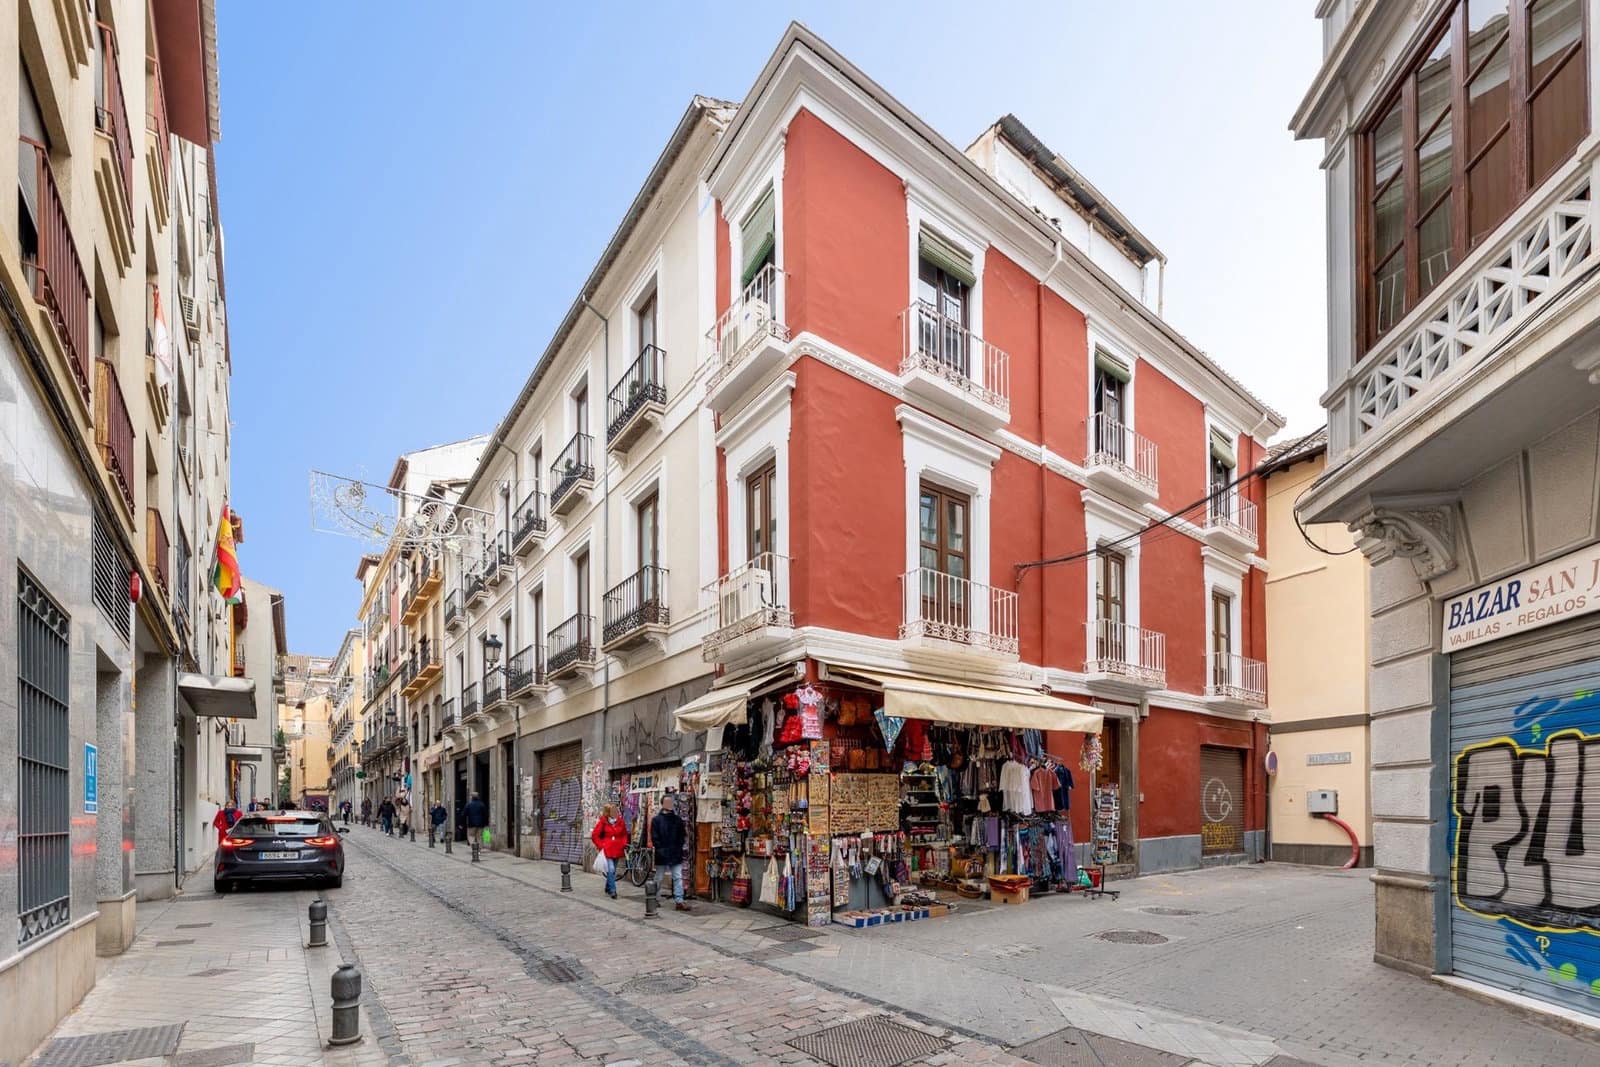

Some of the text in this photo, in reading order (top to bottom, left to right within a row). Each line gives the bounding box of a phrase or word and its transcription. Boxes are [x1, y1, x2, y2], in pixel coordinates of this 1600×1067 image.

[1448, 580, 1521, 630] BAZAR
[1527, 566, 1578, 603] SAN
[1450, 622, 1501, 646] VAJILLAS
[1517, 595, 1587, 626] REGALOS
